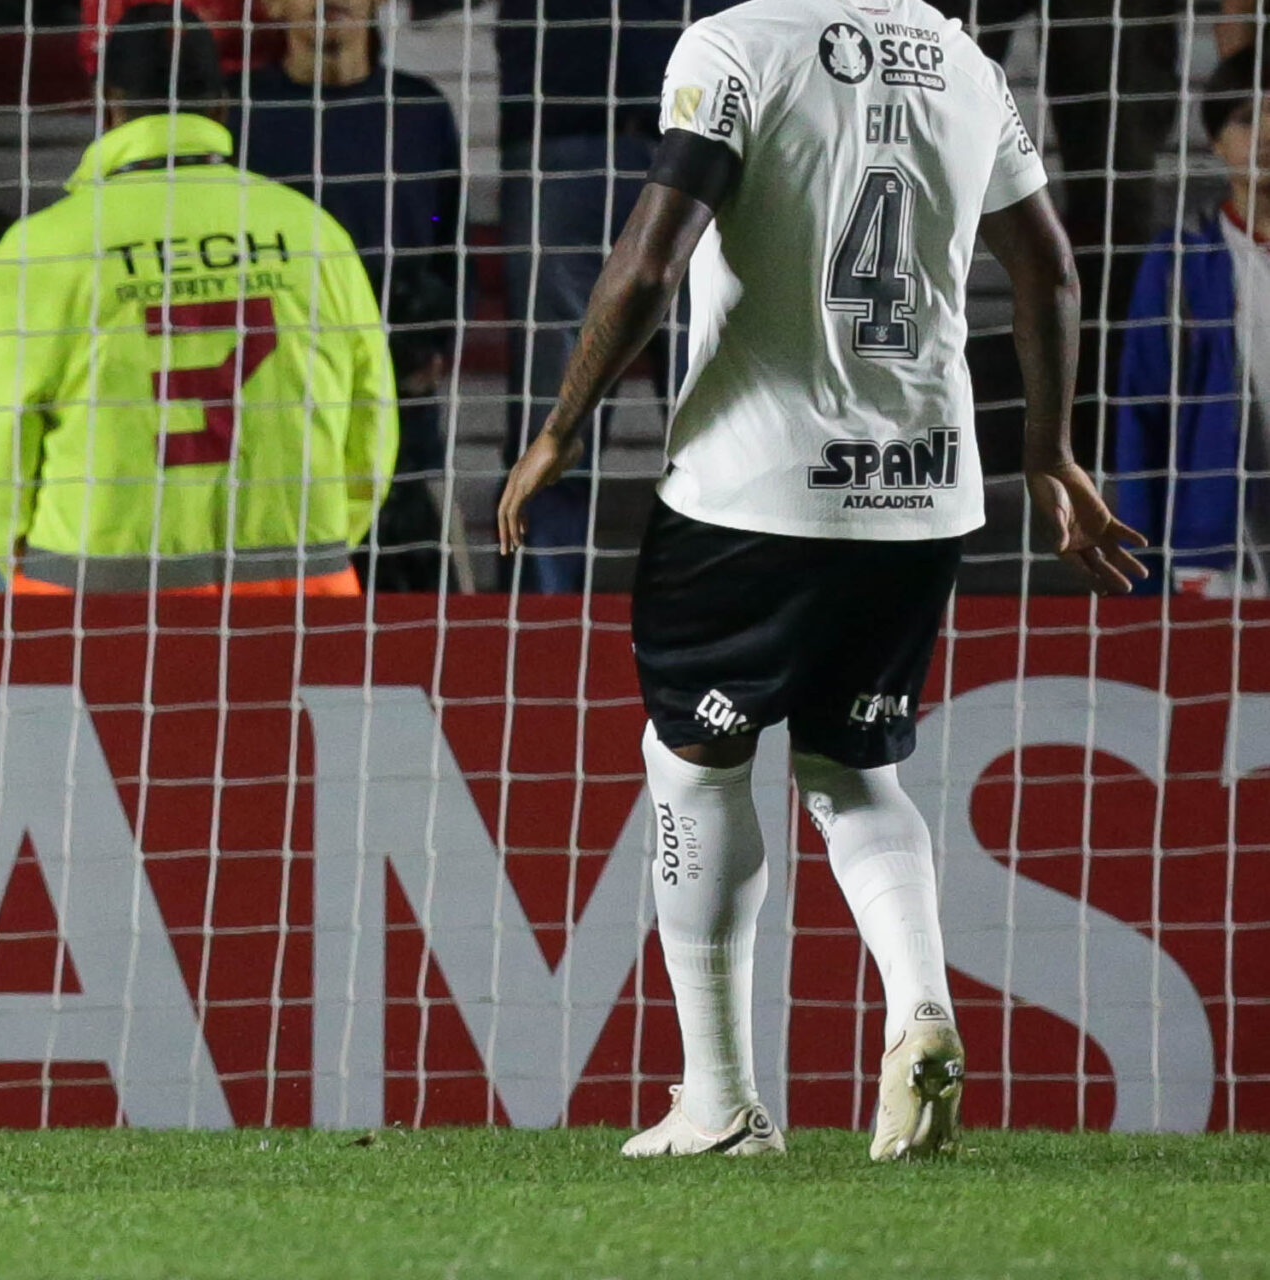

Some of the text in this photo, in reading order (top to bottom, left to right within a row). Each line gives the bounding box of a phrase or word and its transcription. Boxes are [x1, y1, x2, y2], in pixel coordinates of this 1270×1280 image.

[875, 22, 940, 43] UNIVERSO
[880, 39, 943, 71] SCCP
[709, 74, 748, 139] bmg
[866, 104, 909, 144] GIL
[108, 230, 289, 275] TECH
[825, 166, 918, 359] 4
[842, 495, 934, 509] ATACADISTA
[658, 802, 681, 886] TODOS
[680, 816, 704, 880] Cartão de
